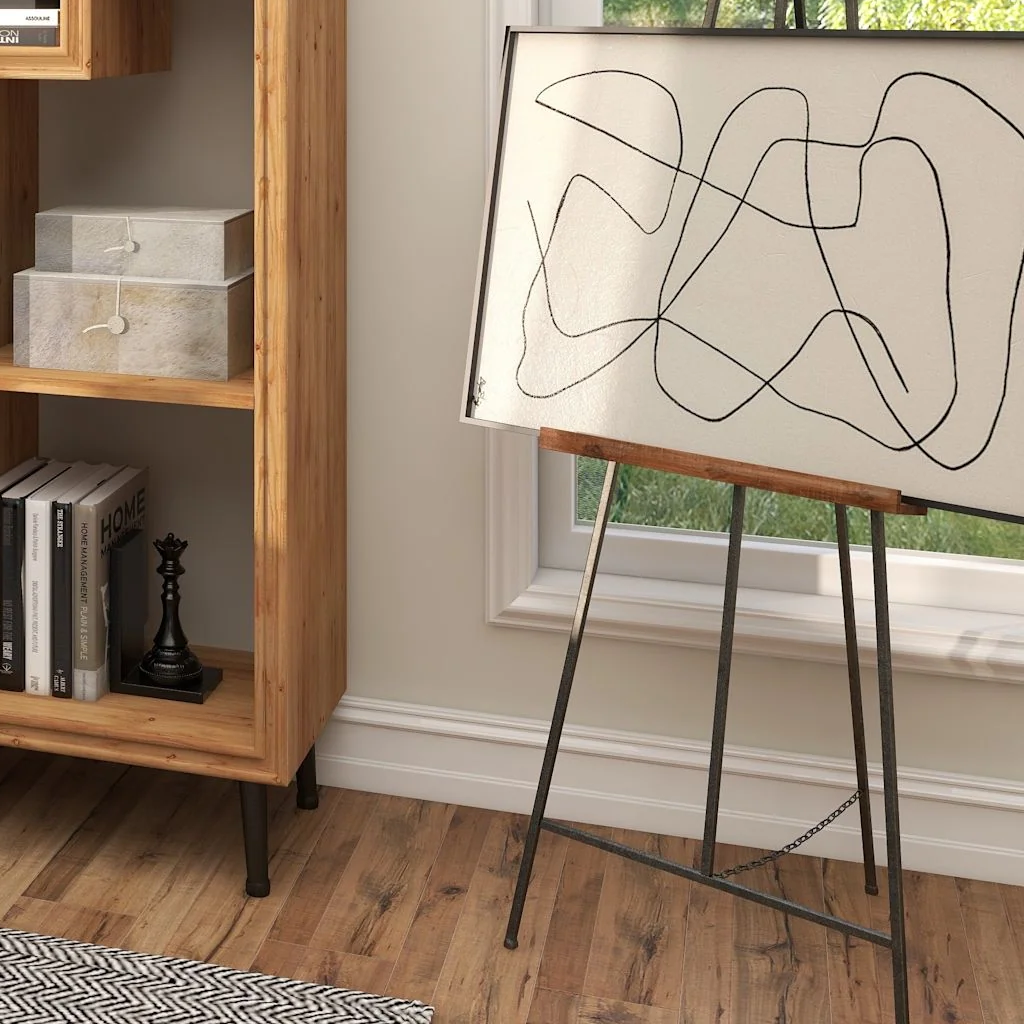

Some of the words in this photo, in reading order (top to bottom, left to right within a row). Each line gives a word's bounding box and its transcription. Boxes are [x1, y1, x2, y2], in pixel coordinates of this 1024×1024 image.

[56, 508, 64, 521] THE
[100, 487, 145, 544] HOME
[56, 520, 64, 548] STRANGER
[80, 522, 88, 546] HOME
[80, 546, 88, 604] MANAGEMENT
[80, 606, 89, 627] PLAIN
[2, 641, 13, 661] WEARY
[80, 634, 88, 661] SIMPLE
